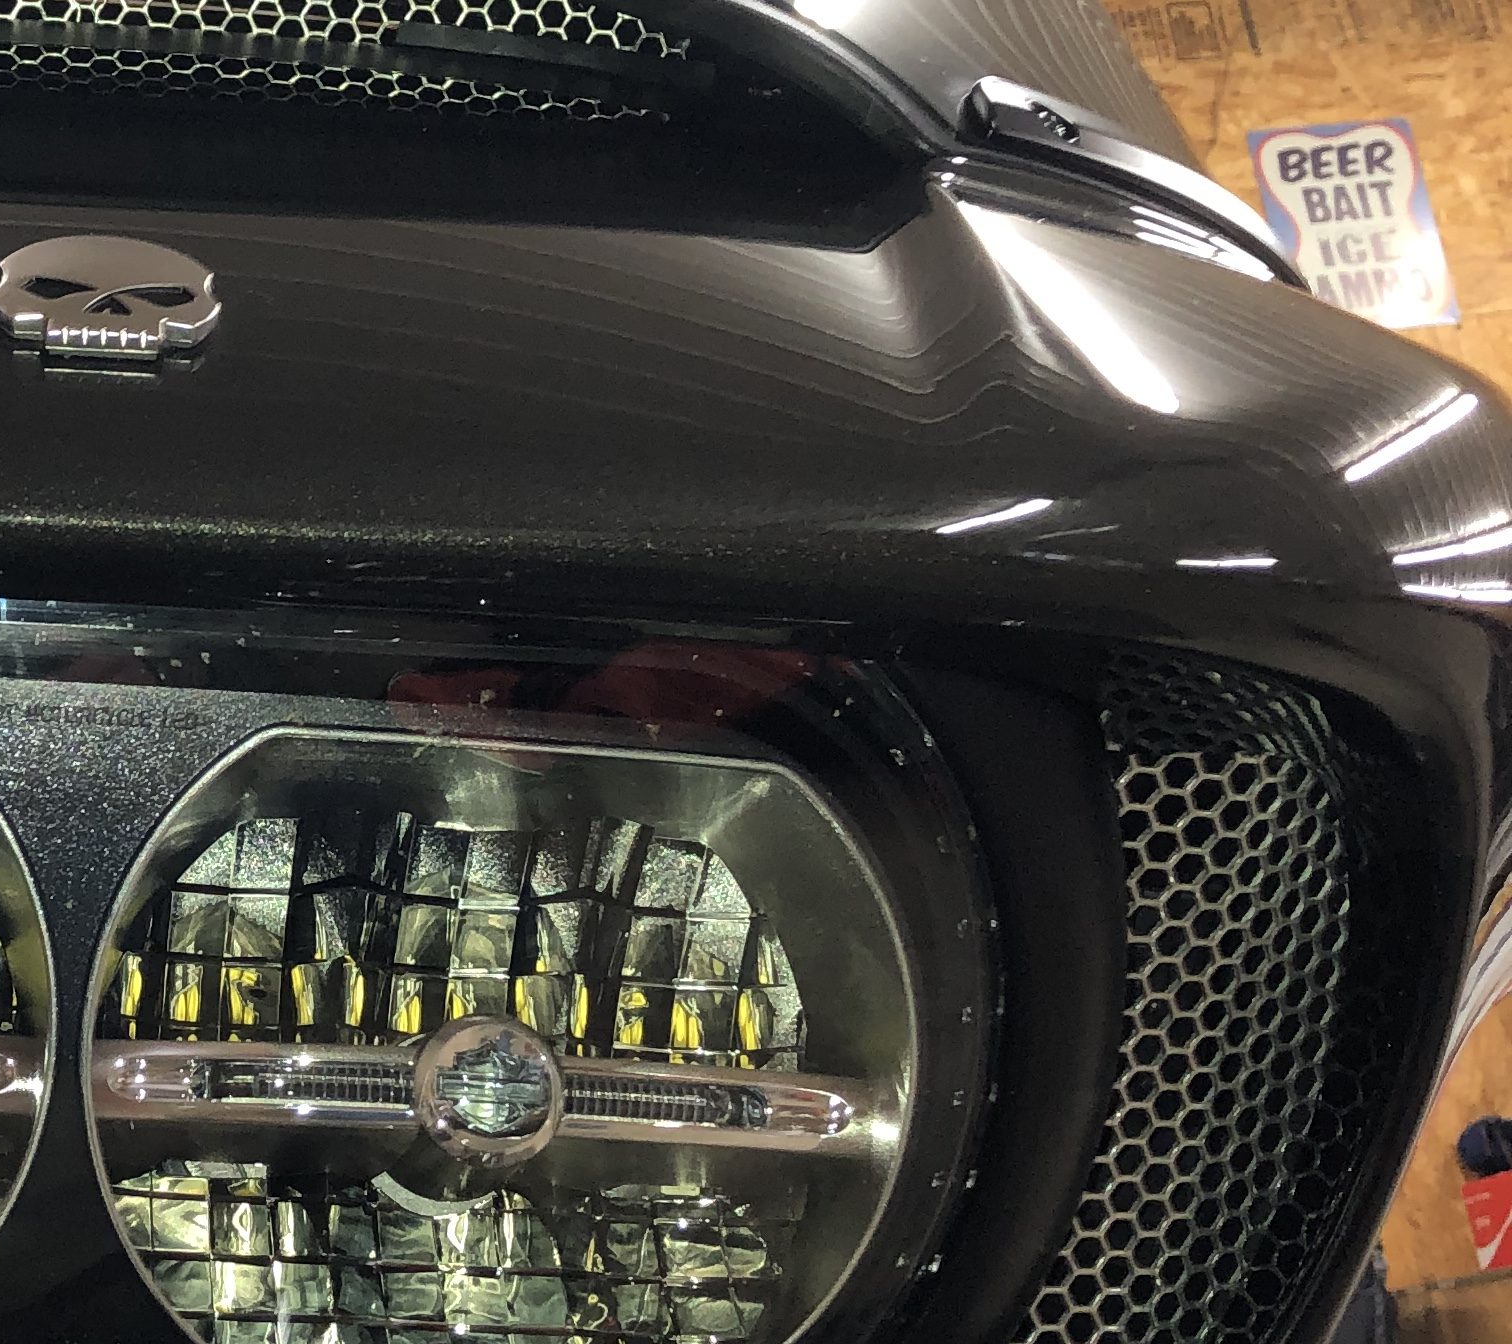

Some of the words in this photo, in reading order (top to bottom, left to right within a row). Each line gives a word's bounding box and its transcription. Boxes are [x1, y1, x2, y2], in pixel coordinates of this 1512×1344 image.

[1277, 139, 1395, 183] BEER
[1303, 181, 1393, 224] BAIT
[1318, 228, 1402, 267] ICE
